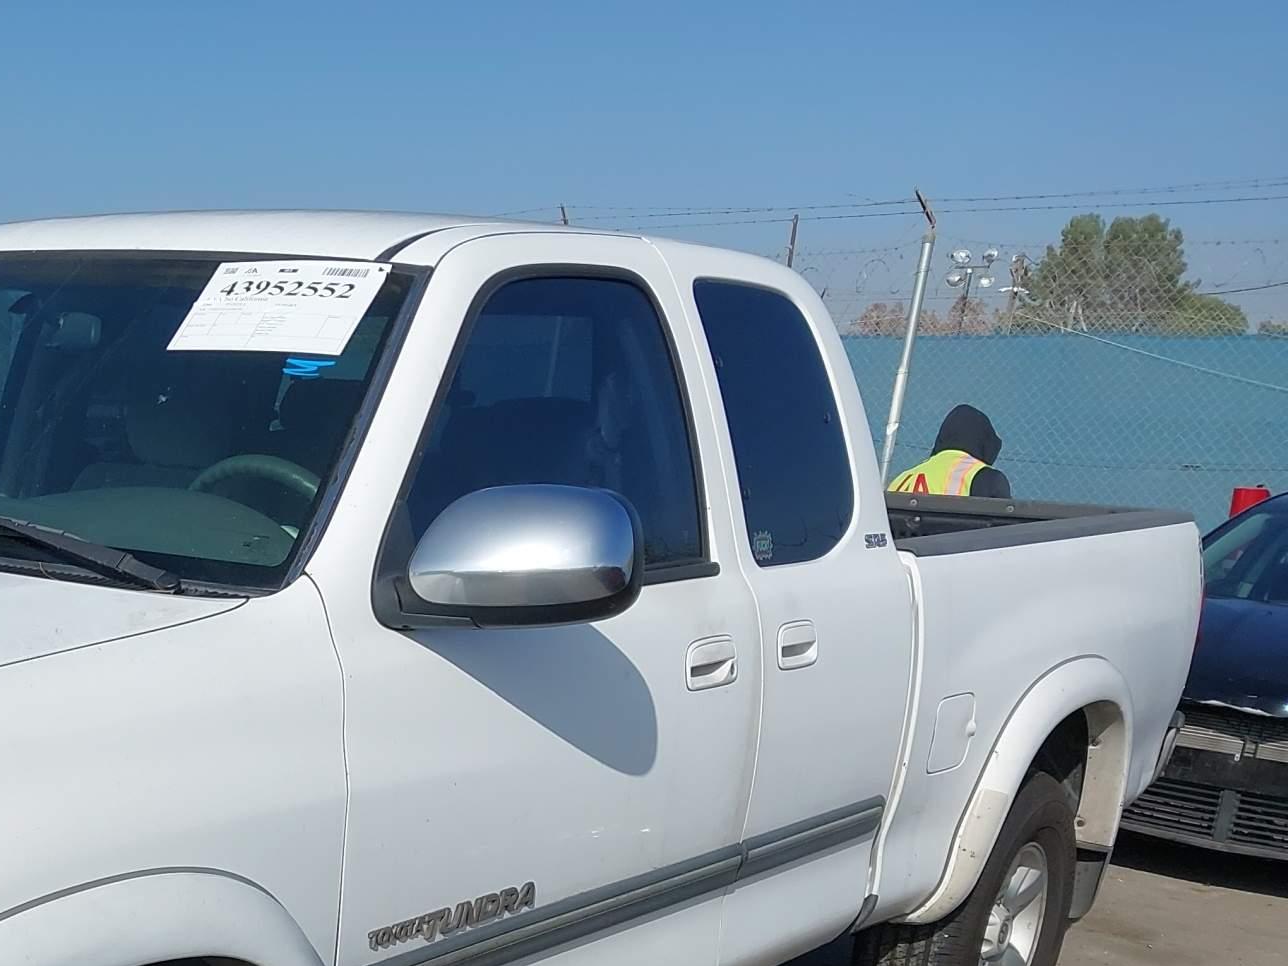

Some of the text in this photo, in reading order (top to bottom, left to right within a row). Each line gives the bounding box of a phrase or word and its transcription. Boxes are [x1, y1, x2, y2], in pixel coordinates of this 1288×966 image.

[220, 280, 355, 299] 43952552
[367, 880, 537, 952] TOYOTA TUNDRA
